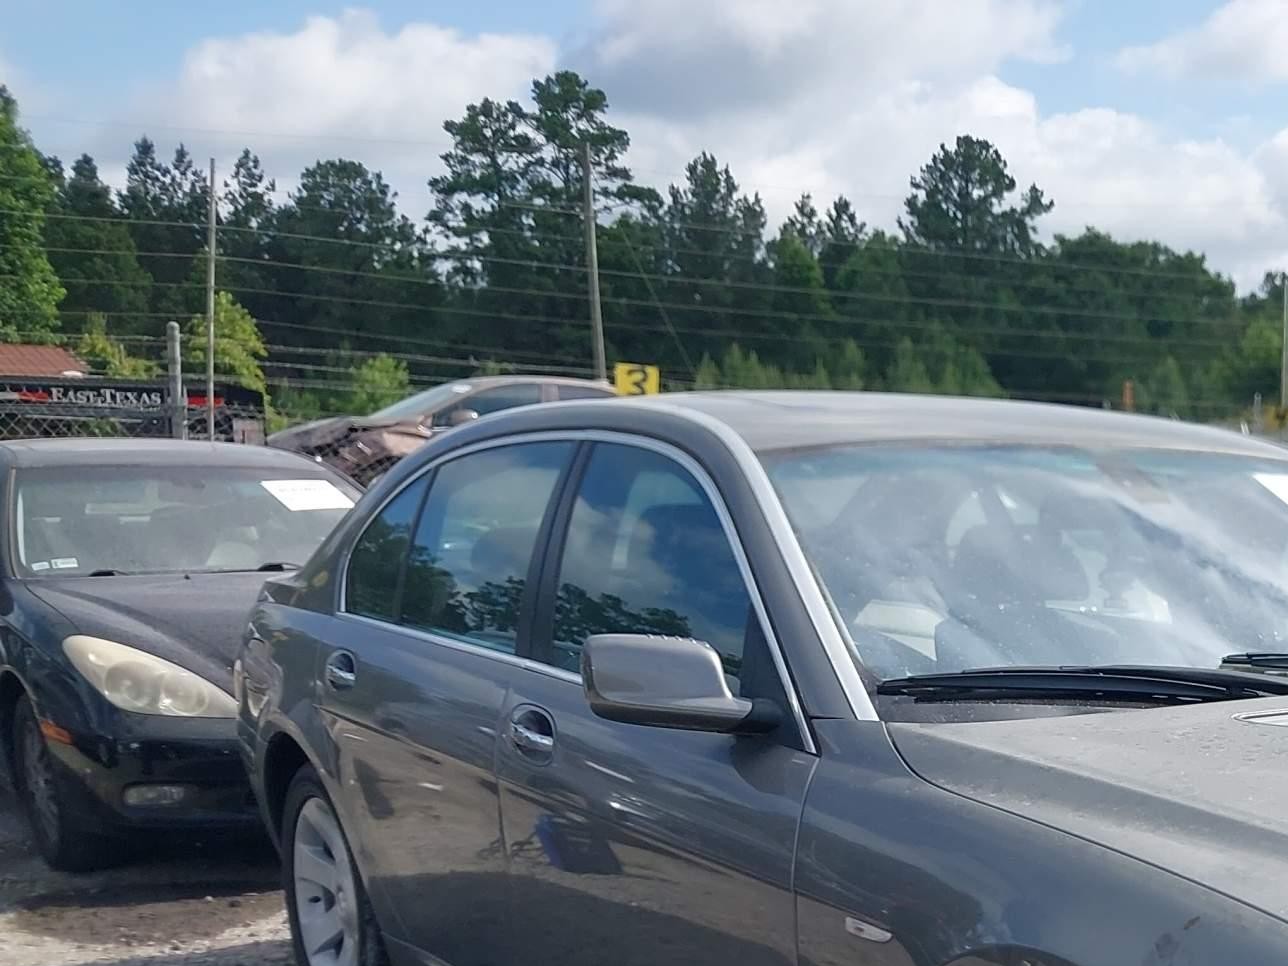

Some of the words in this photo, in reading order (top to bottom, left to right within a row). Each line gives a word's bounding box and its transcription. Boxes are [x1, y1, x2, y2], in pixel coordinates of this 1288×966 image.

[626, 368, 648, 396] 3
[49, 387, 98, 404] EAST
[100, 388, 161, 406] TEXAS
